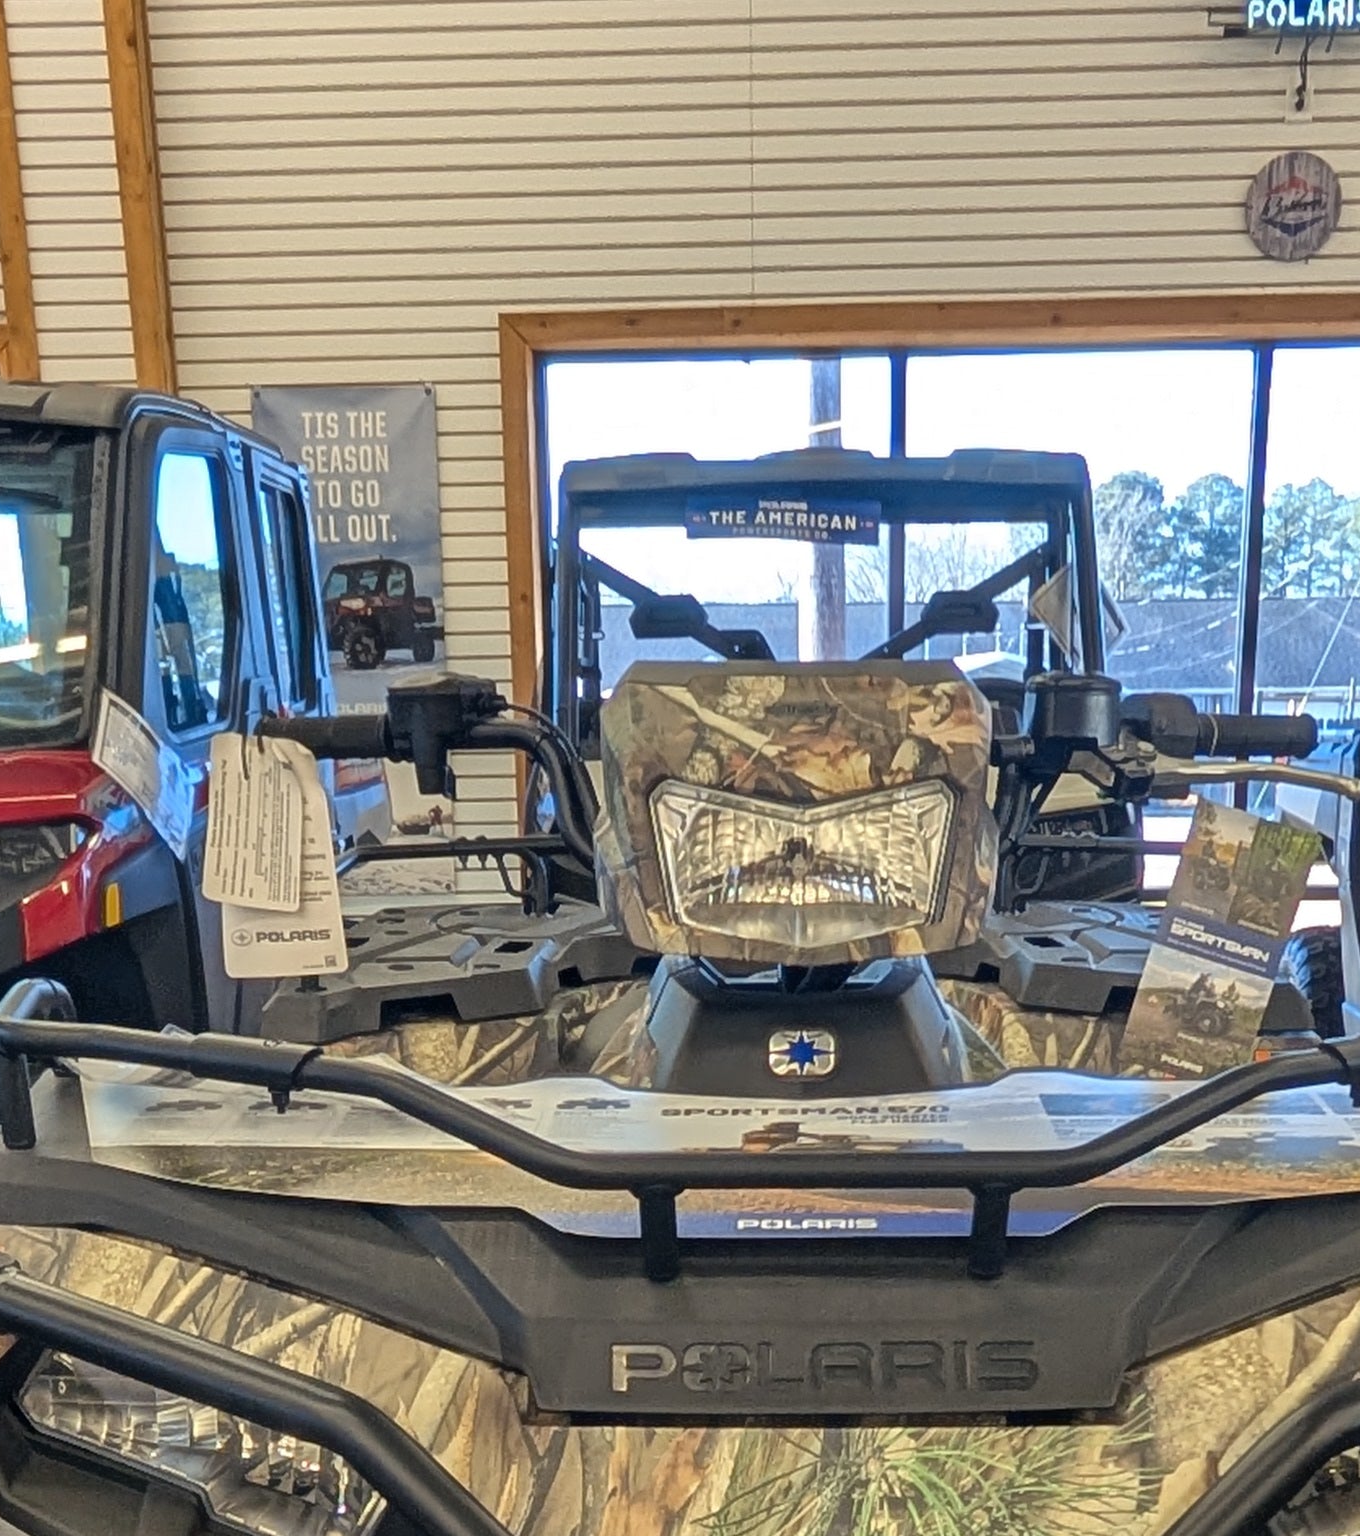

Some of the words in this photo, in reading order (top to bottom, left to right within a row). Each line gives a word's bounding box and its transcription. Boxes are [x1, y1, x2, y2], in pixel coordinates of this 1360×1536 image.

[301, 411, 339, 439] TIS
[346, 411, 387, 439] THE
[301, 444, 389, 473] SEASON
[313, 480, 341, 508] TO
[351, 480, 380, 508] GO
[317, 515, 340, 542] LL
[347, 514, 397, 542] OUT.
[709, 510, 746, 525] THE
[755, 511, 856, 530] AMERICAN
[256, 929, 332, 944] POLARIS
[1170, 922, 1270, 963] SPORTSMAN
[661, 1106, 879, 1117] SPORTSMAN
[737, 1218, 878, 1229] POLARIS
[609, 1340, 1039, 1394] POLARIS
